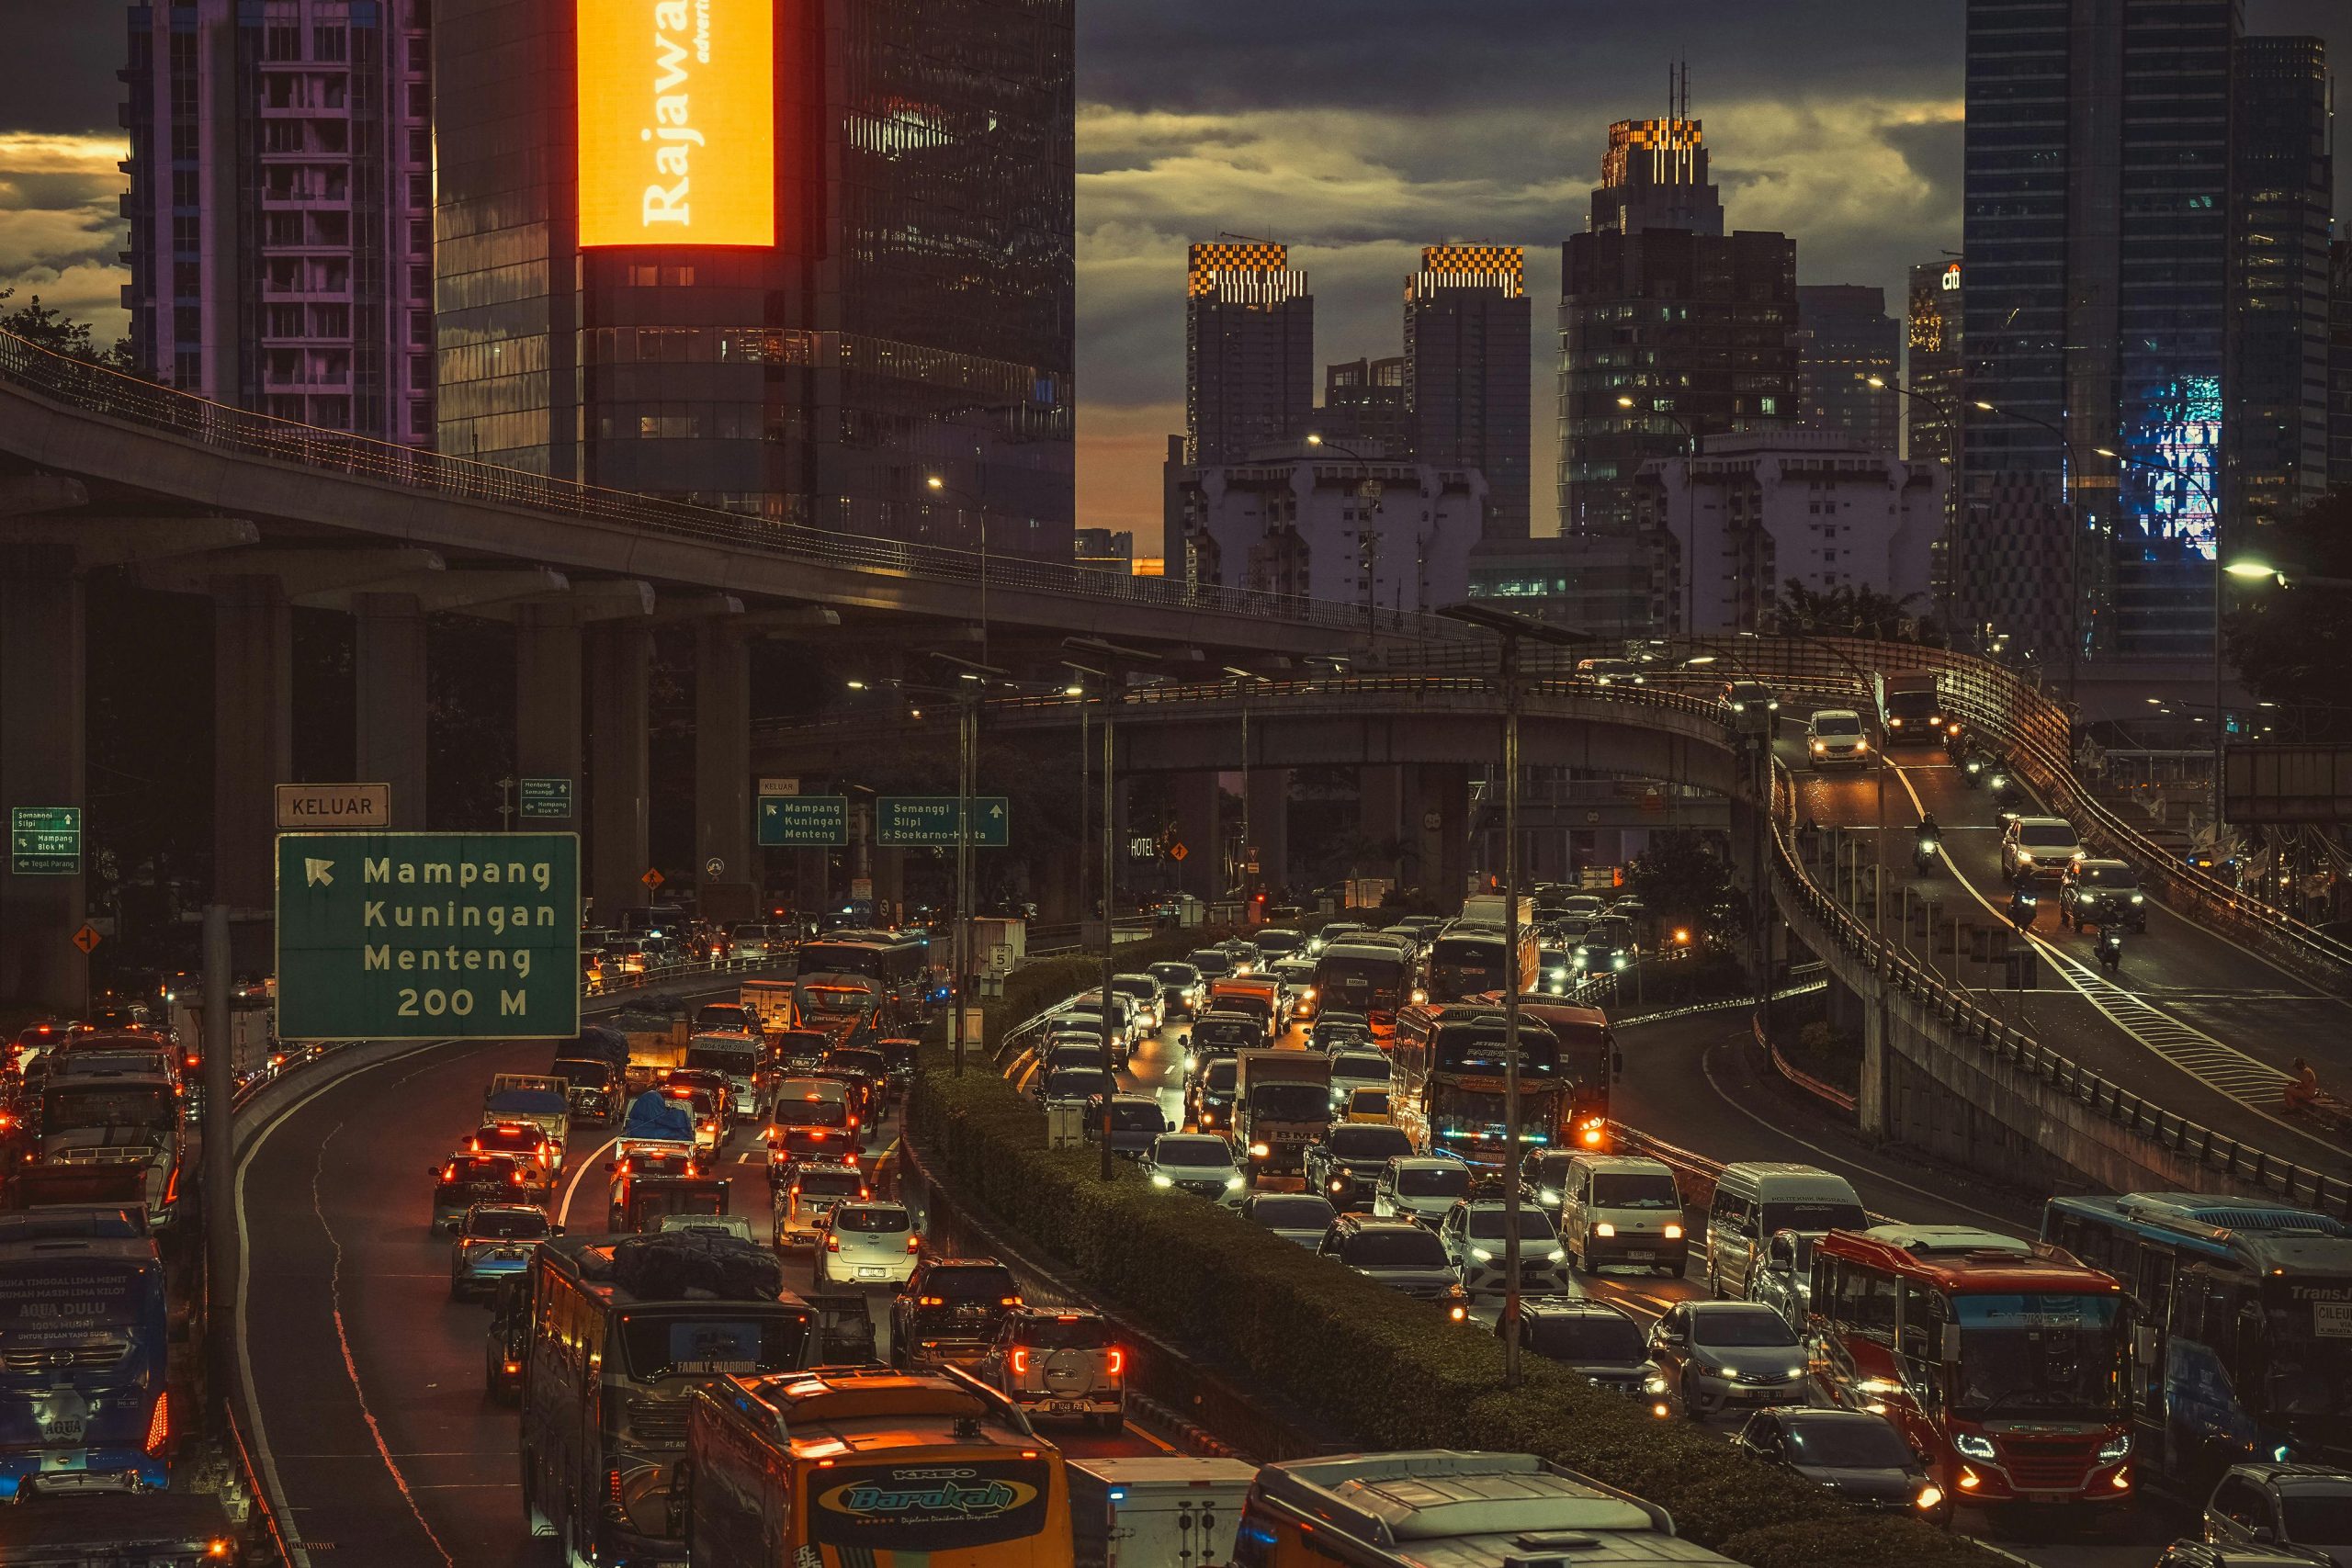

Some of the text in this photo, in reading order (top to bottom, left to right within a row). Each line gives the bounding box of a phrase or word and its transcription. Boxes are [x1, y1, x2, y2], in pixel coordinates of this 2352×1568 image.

[292, 798, 372, 815] KELUAR
[785, 804, 840, 815] Mampang
[894, 804, 949, 815] Semanggi
[18, 812, 52, 820] Semanggi
[785, 817, 842, 828] Kuningan
[894, 817, 921, 828] Slipi
[38, 834, 73, 842] Mampang
[785, 829, 835, 840] Menteng
[894, 830, 986, 840] Soekarno-Hta
[1131, 838, 1154, 856] HOTEL
[364, 857, 550, 892] Mampang
[364, 901, 555, 935] Kuningan
[364, 944, 530, 979] Menteng
[997, 954, 1005, 965] 5
[398, 988, 526, 1017] 200 M
[811, 1015, 841, 1023] garuda
[27, 1277, 71, 1286] TINGGAL
[71, 1277, 96, 1285] LIMA
[96, 1276, 128, 1284] MENIT
[0, 1291, 34, 1299] RUMAH
[37, 1290, 71, 1298] MASIH
[19, 1303, 106, 1318] AQUA DULU
[32, 1323, 58, 1331] 100%
[677, 1361, 756, 1373] FAMILY WARRIOR
[46, 1420, 82, 1436] AQUA
[893, 1469, 977, 1480] KREO
[847, 1481, 1012, 1513] Barokah
